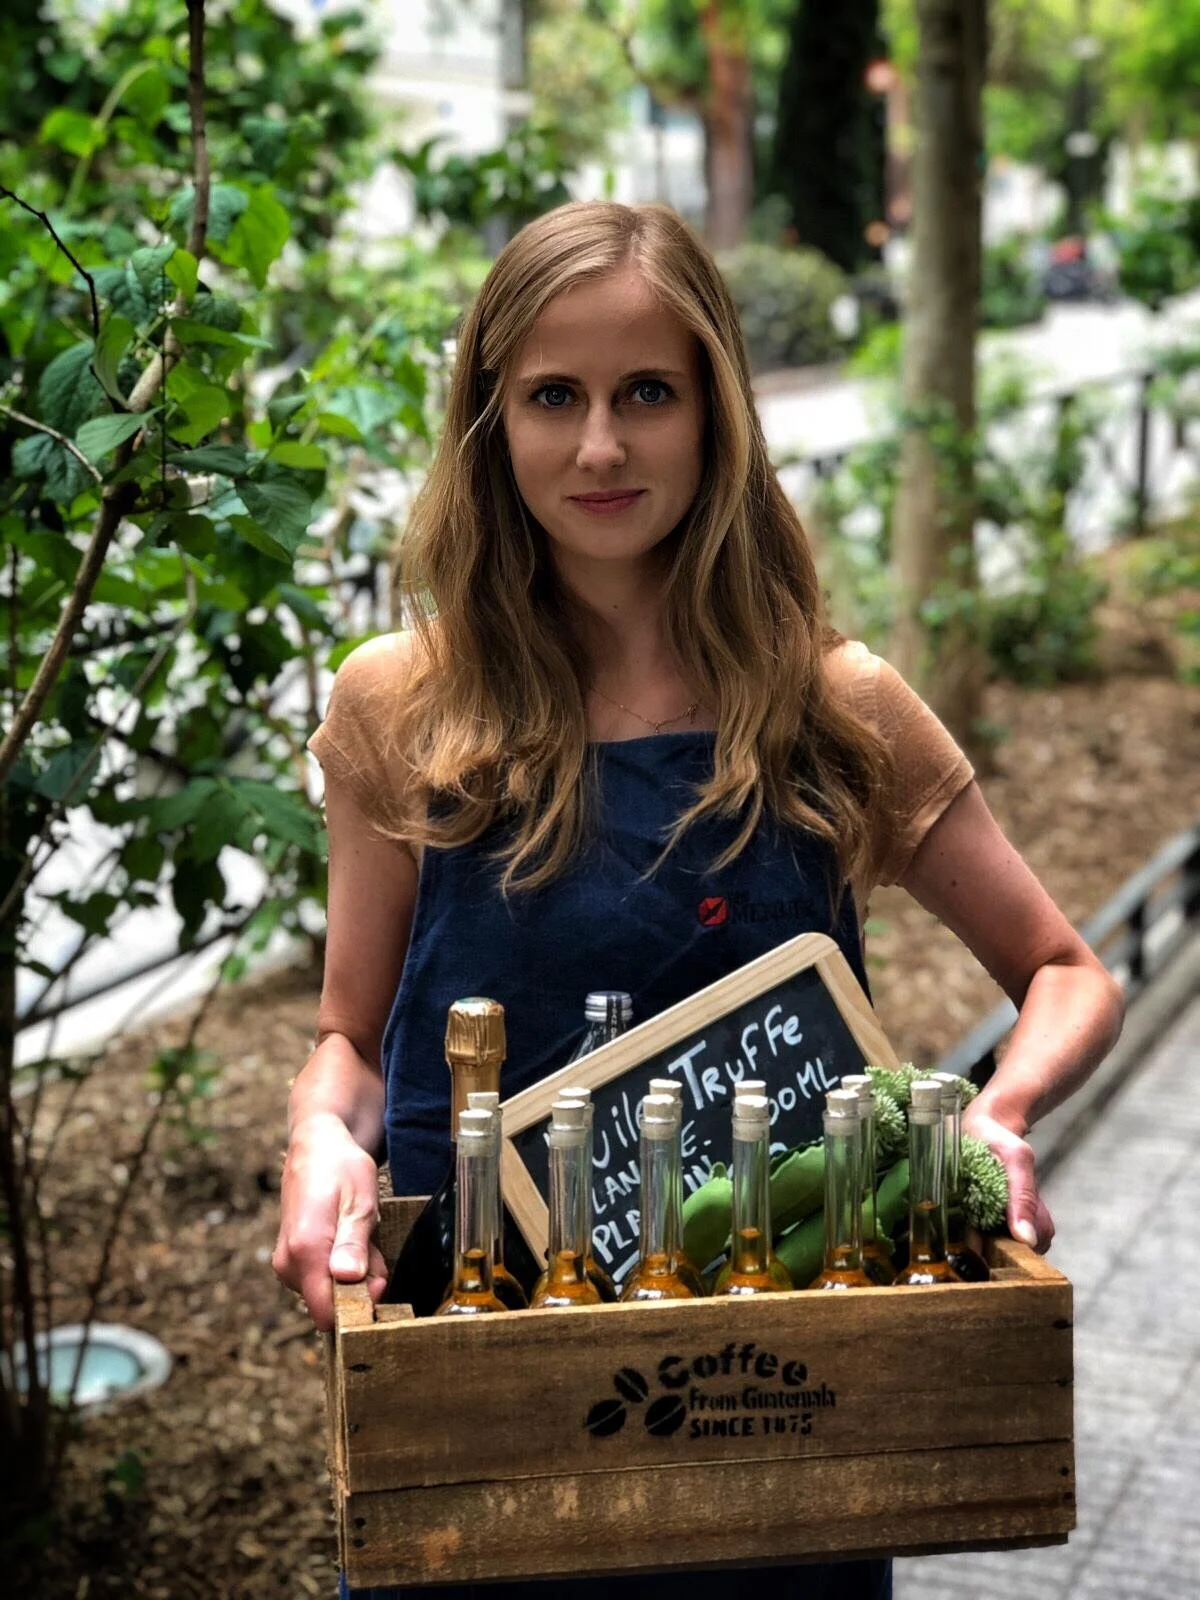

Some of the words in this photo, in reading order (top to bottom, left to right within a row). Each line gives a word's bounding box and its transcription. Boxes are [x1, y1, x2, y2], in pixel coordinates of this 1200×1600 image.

[543, 1091, 643, 1169] uil
[658, 1343, 808, 1388] Coffee
[689, 1416, 755, 1438] SINCE
